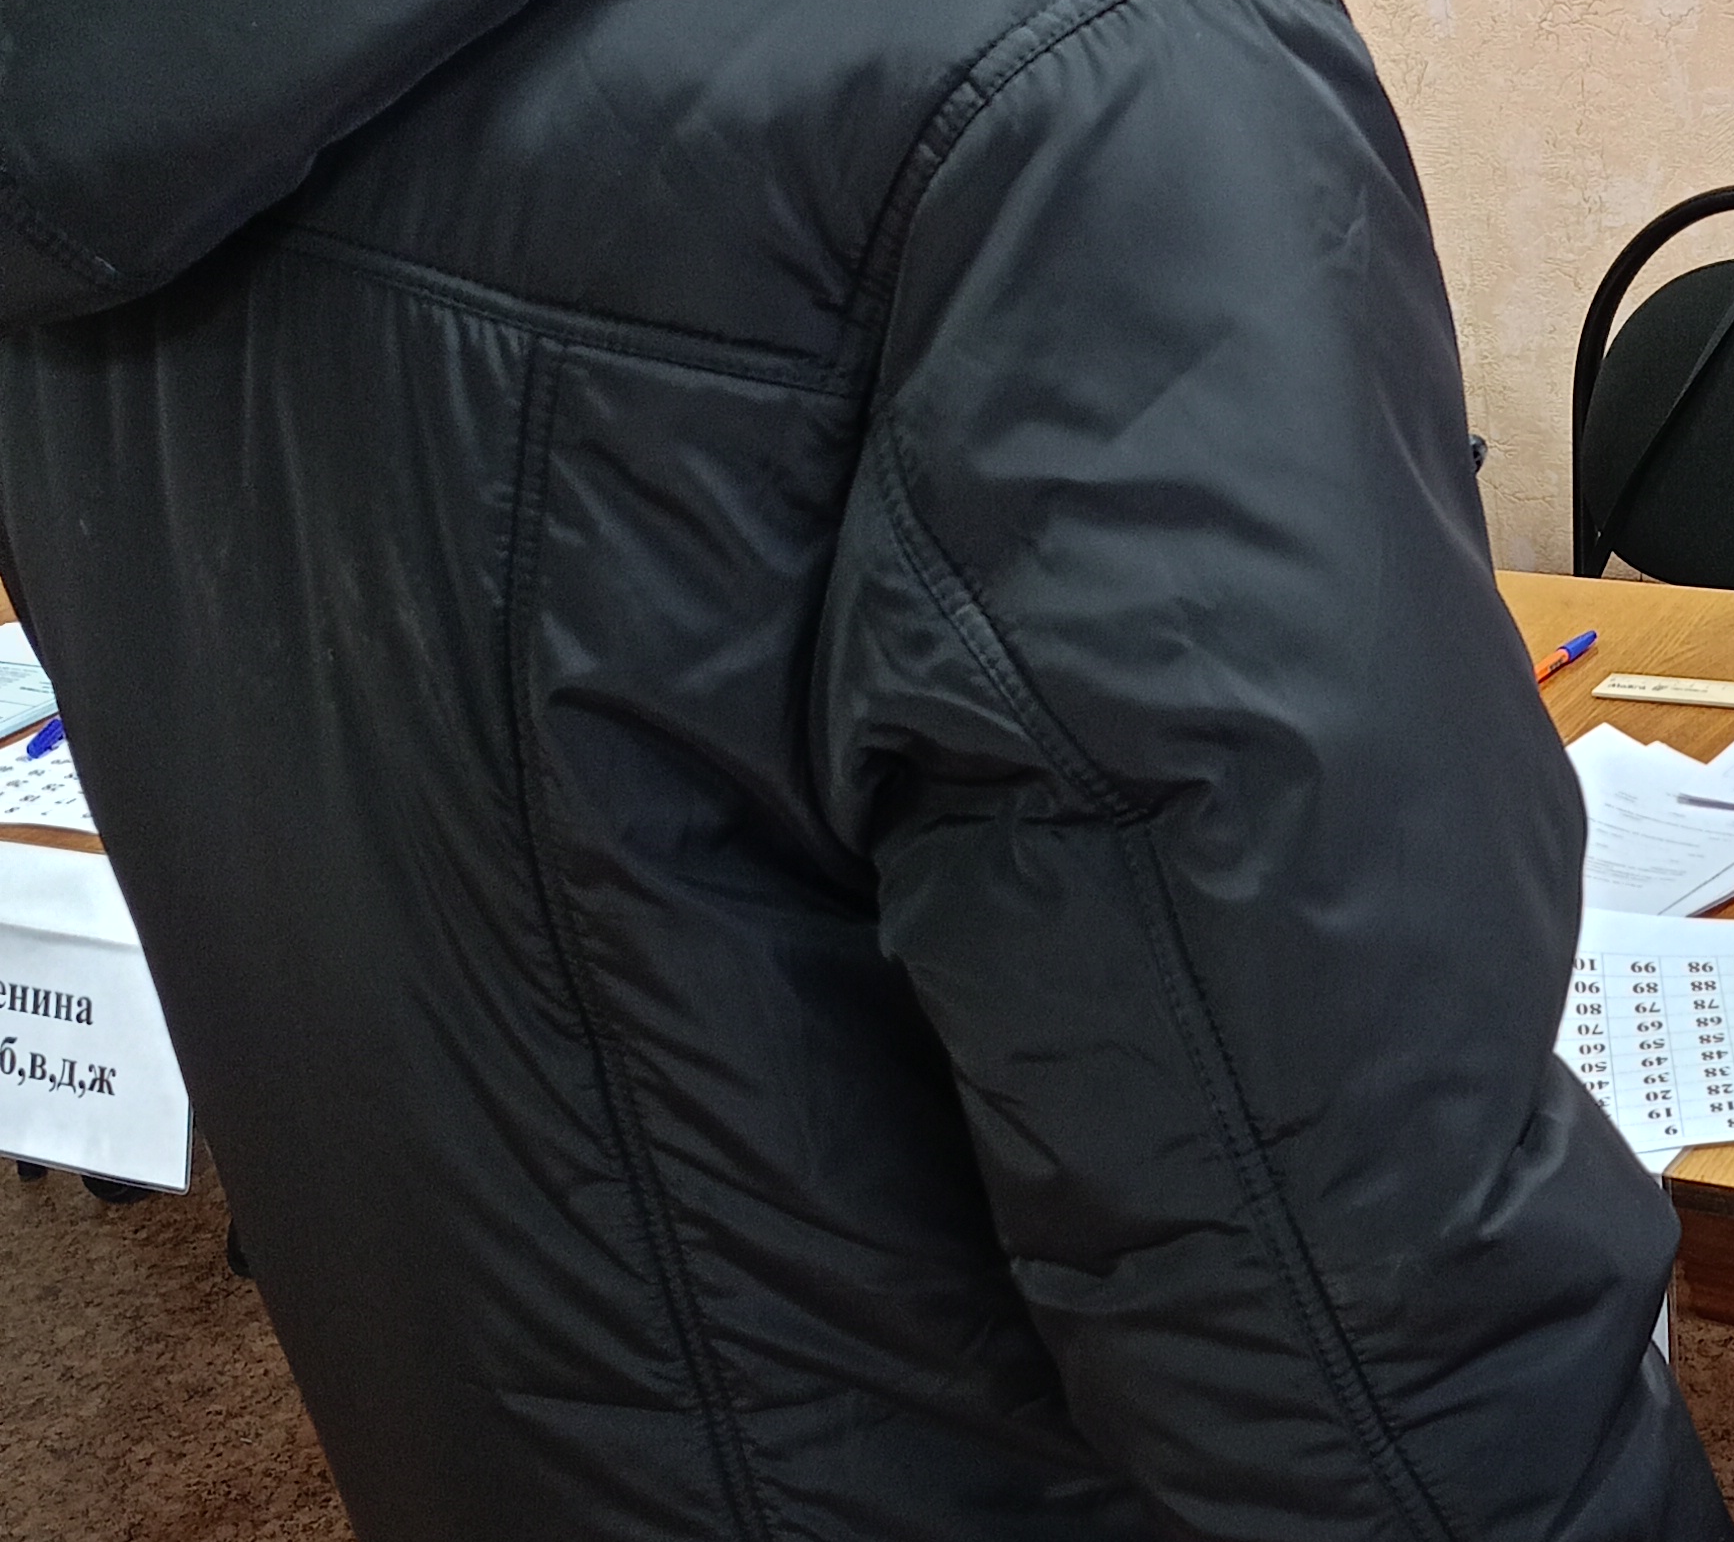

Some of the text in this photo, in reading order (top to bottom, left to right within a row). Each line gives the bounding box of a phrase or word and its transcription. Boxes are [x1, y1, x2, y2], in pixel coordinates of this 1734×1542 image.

[1573, 959, 1598, 971] 10
[1630, 961, 1657, 973] 99
[1687, 962, 1714, 973] 98
[1574, 981, 1600, 994] 90
[1632, 982, 1659, 994] 89
[1690, 980, 1717, 992] 88
[1575, 1003, 1602, 1015] 80
[1634, 1001, 1661, 1014] 79
[1693, 998, 1720, 1010] 78
[0, 1036, 116, 1099] б,в,д,ж
